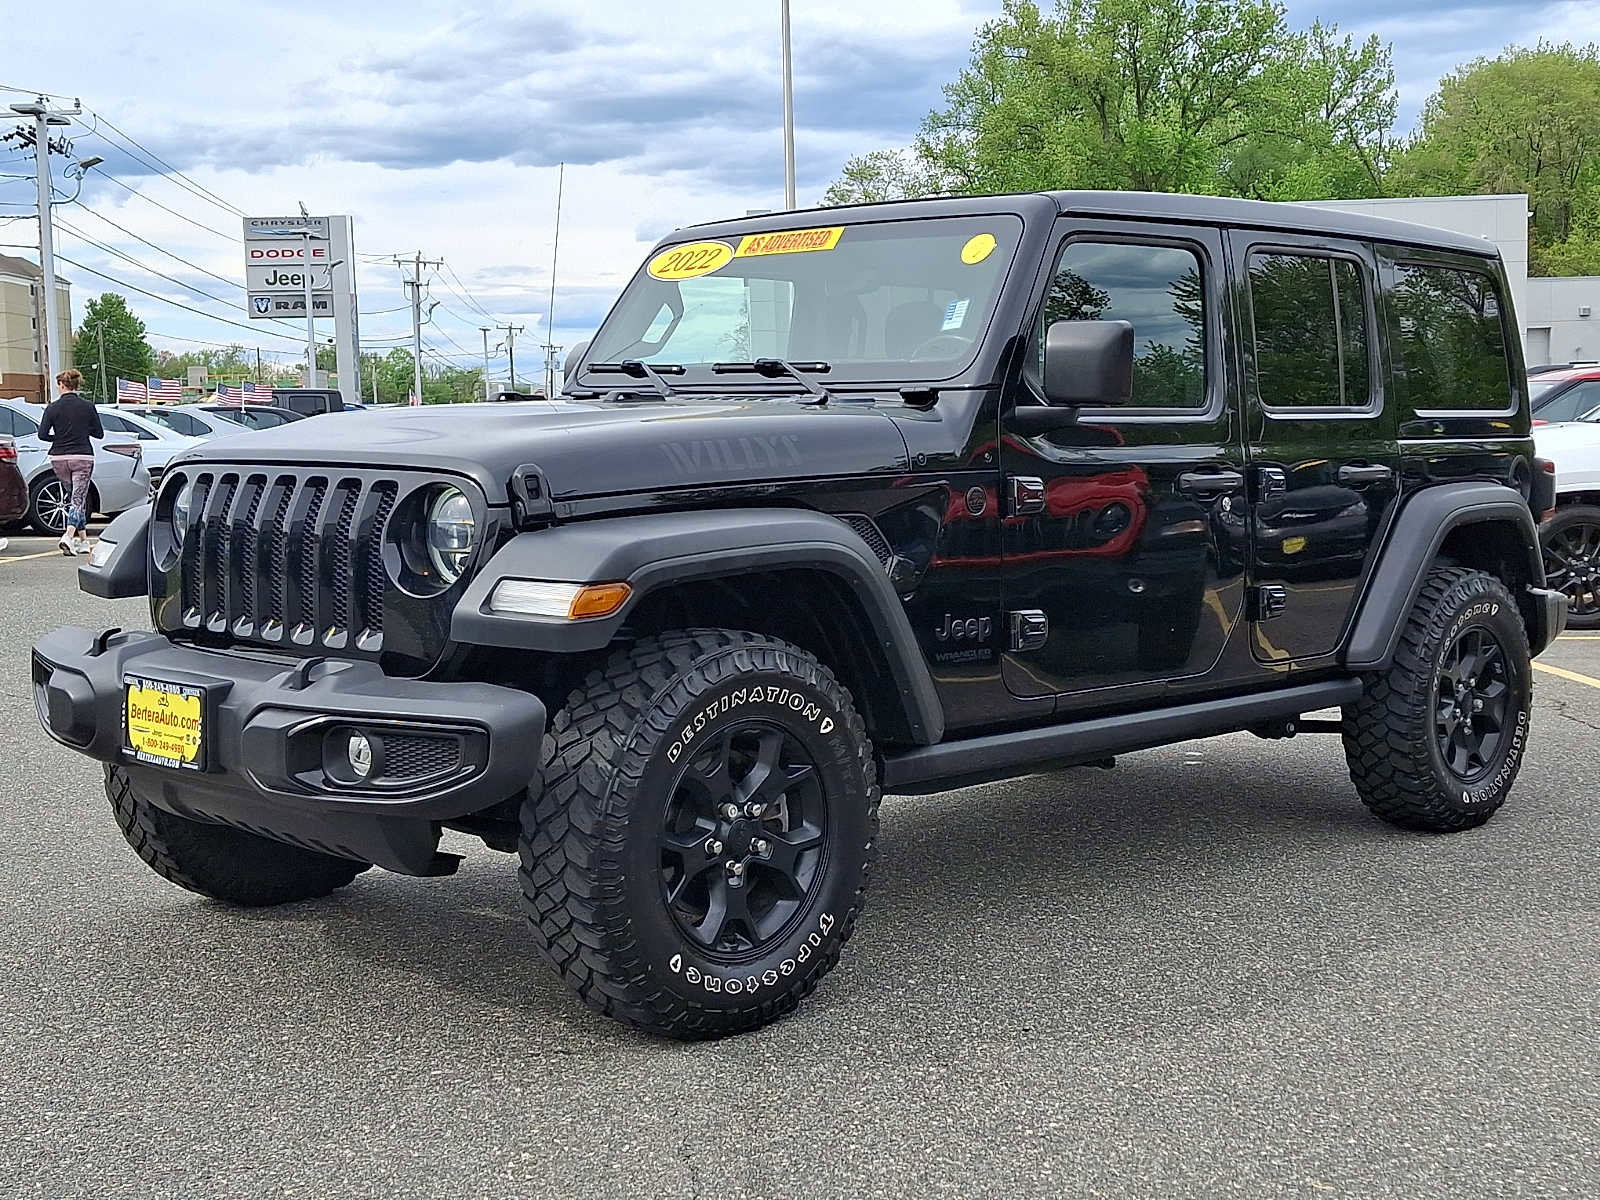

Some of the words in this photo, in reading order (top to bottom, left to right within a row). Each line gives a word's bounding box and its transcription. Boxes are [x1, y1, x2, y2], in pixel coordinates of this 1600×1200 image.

[745, 237, 765, 255] AS
[765, 231, 832, 251] ADVERTISED
[657, 248, 722, 273] 2022
[265, 270, 315, 288] Jeep
[275, 301, 328, 310] RAM
[936, 613, 992, 642] Jeep
[131, 703, 199, 731] BerteraAuto.com
[667, 686, 821, 763] DESTINATION
[686, 912, 834, 994] Firestone
